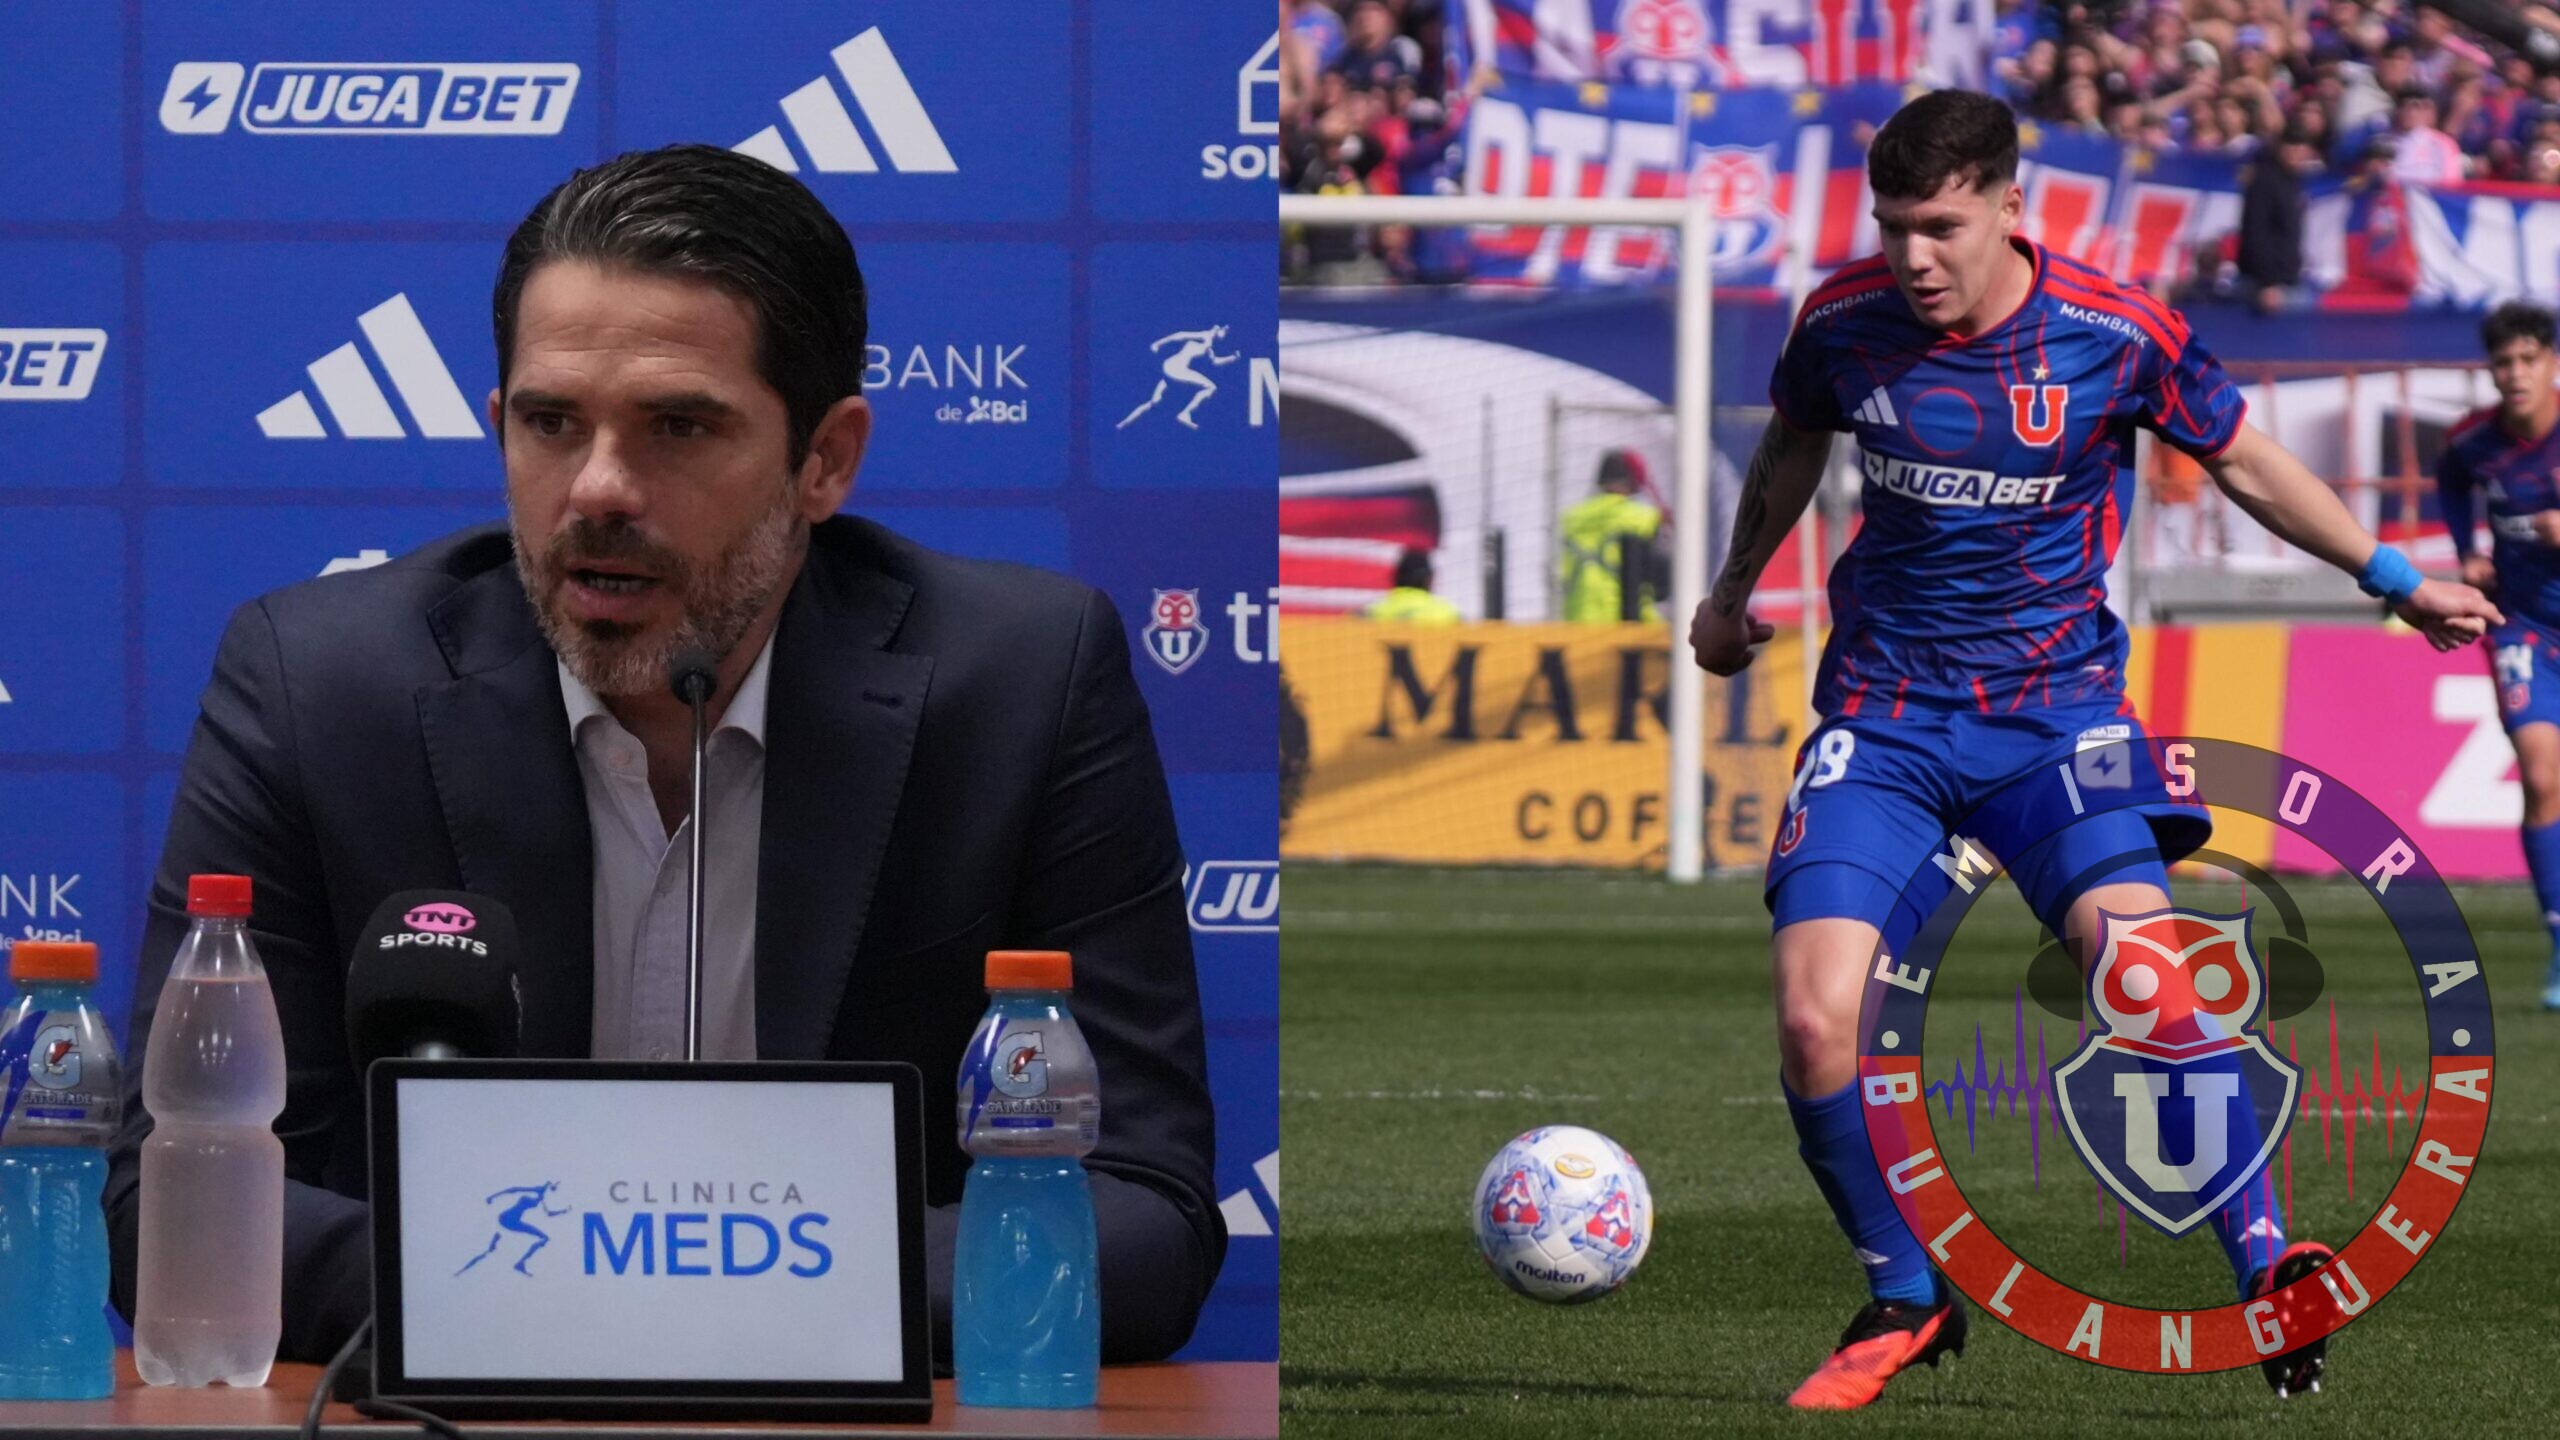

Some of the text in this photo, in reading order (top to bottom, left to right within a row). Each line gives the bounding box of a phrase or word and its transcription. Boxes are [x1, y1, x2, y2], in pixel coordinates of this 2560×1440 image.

[1806, 288, 1887, 328] MACHBANK
[2060, 303, 2149, 348] MACHBANK
[0, 341, 95, 386] ET
[861, 344, 1028, 388] BANK
[935, 400, 1027, 421] de Bci
[2010, 385, 2068, 446] U
[1516, 791, 1763, 842] COFE
[406, 910, 475, 927] TNT
[379, 932, 488, 956] SPORTS
[609, 1181, 803, 1204] CLINICA
[583, 1212, 833, 1278] MEDS
[1515, 1260, 1585, 1284] molten
